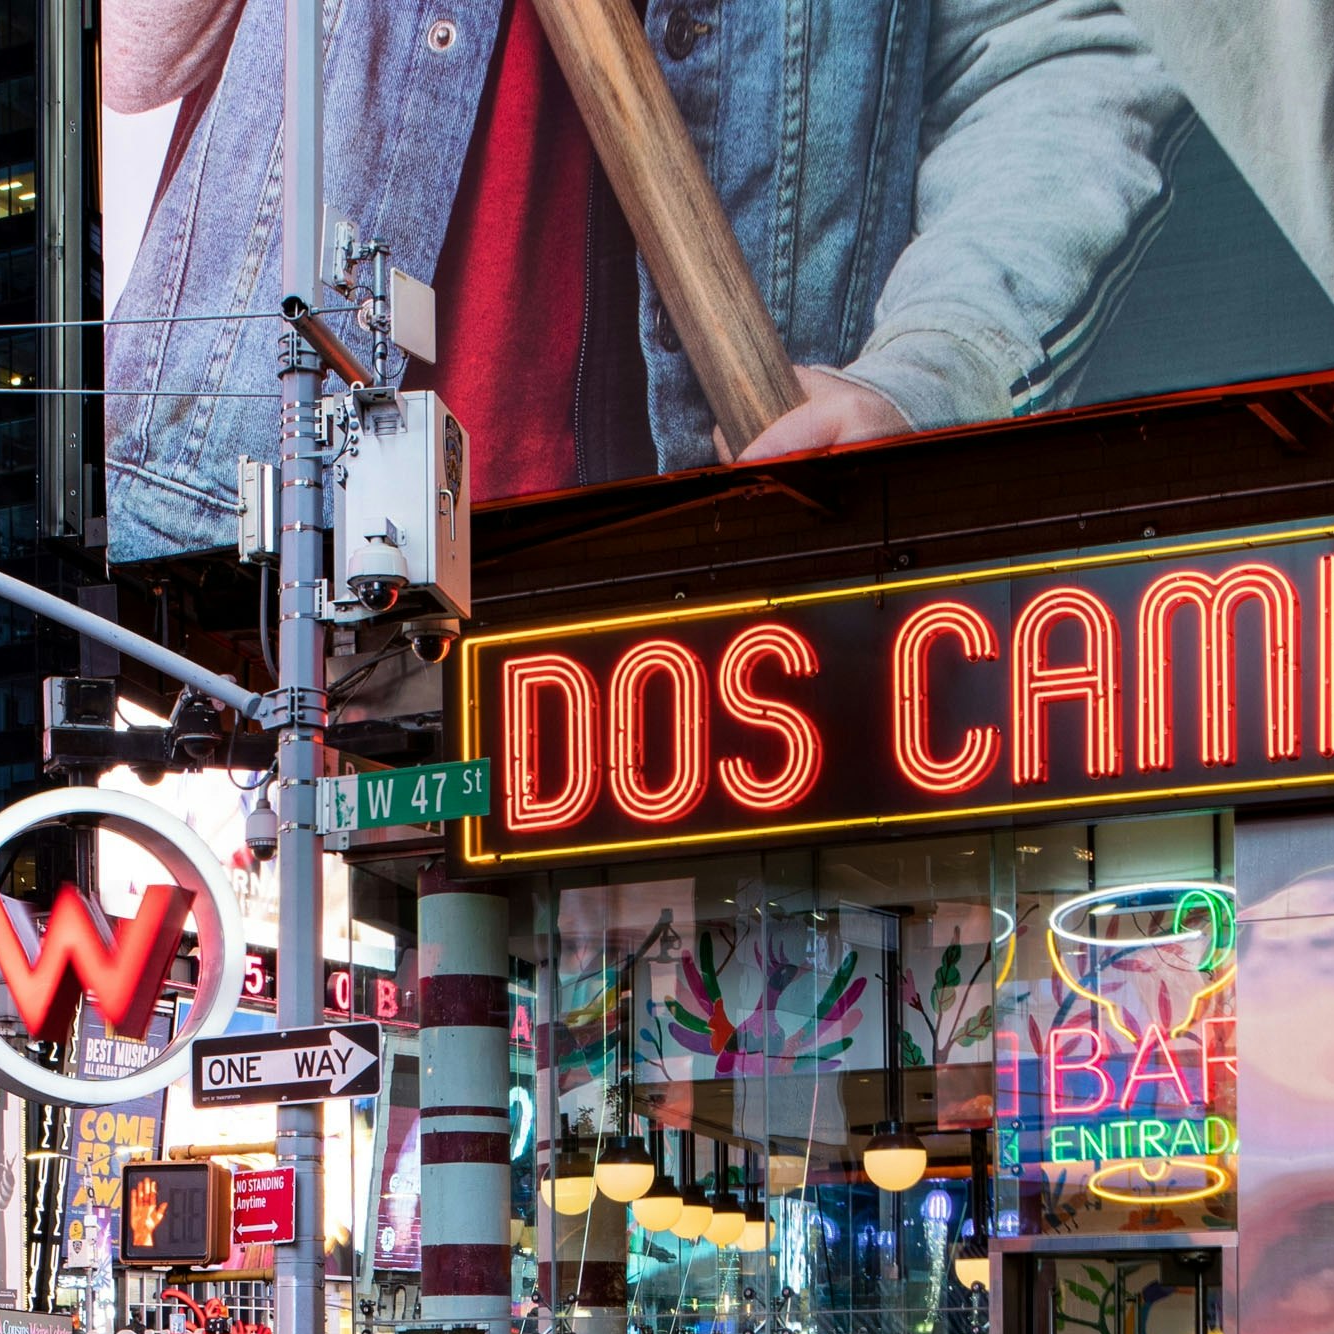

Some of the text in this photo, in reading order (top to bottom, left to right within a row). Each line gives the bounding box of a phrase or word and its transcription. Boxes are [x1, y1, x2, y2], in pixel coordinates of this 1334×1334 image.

[503, 623, 823, 833] DOS
[367, 768, 482, 820] W 47 St
[84, 1062, 95, 1075] ALL
[86, 1038, 114, 1063] BEST
[208, 1047, 354, 1086] ONE WAY
[80, 1109, 156, 1147] COME
[1050, 1116, 1241, 1165] ENTRAD
[236, 1176, 285, 1194] NO STANDING
[236, 1195, 267, 1212] Anytime
